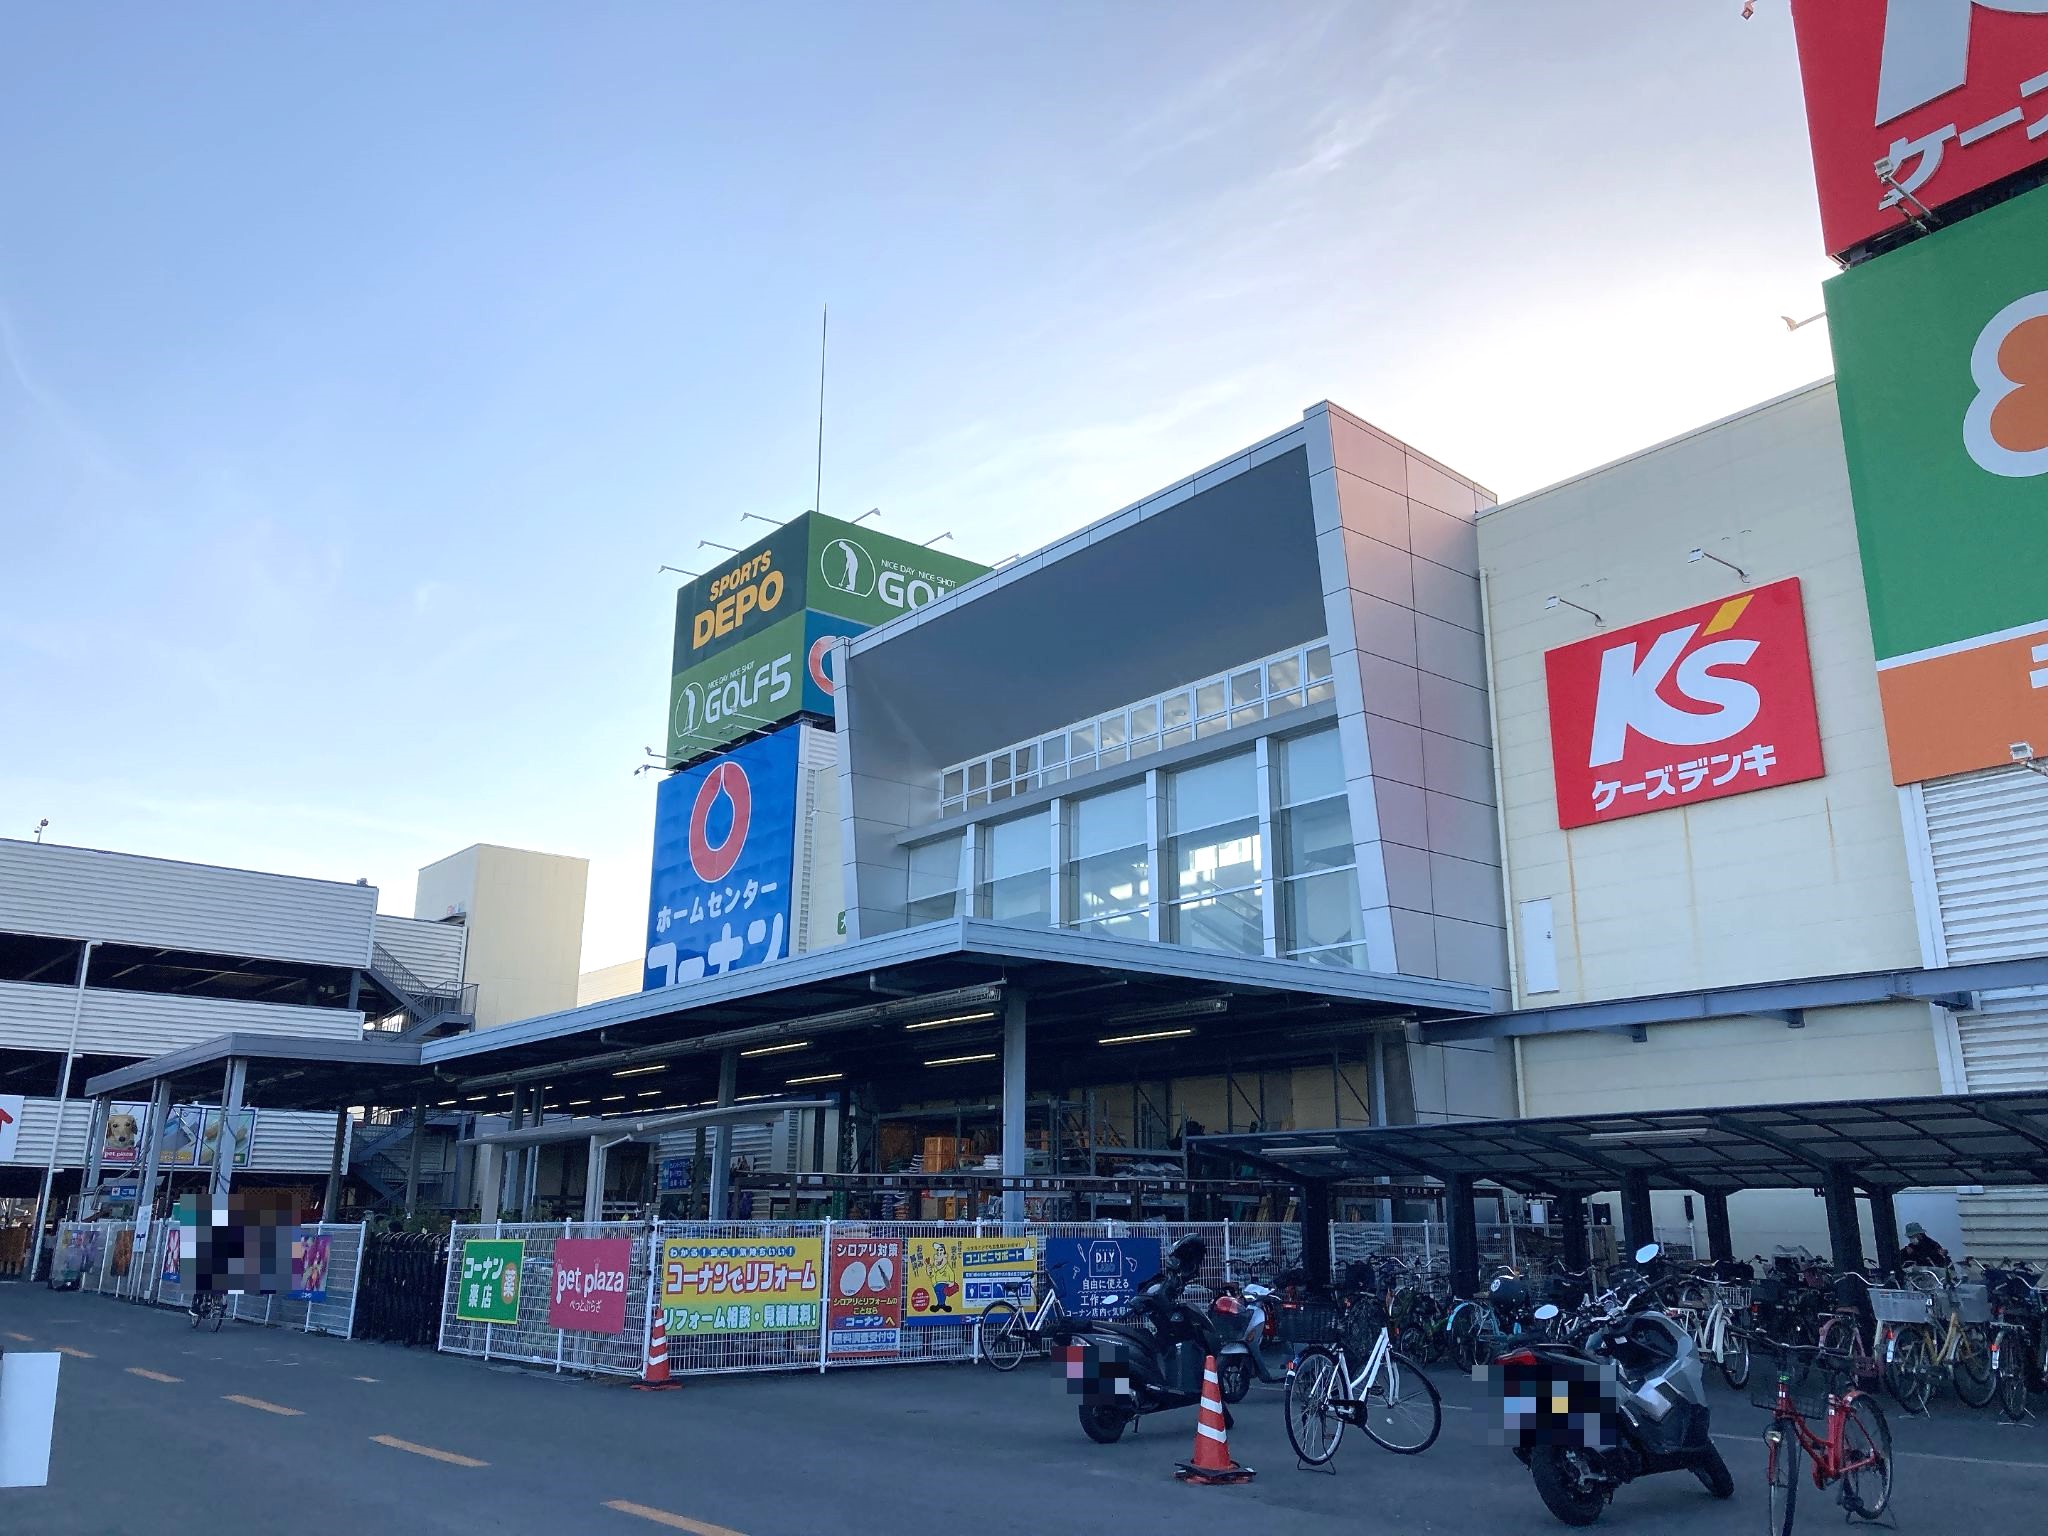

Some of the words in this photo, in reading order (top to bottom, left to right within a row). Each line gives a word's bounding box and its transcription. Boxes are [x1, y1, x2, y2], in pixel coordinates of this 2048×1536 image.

[709, 549, 772, 602] SPORTS
[881, 559, 899, 571] NICE
[900, 564, 916, 576] DAY
[918, 570, 935, 582] NICE
[936, 576, 957, 588] SHOT
[692, 570, 784, 650] DEPO
[705, 653, 792, 724] GOLF5
[707, 679, 719, 690] NICE
[719, 674, 729, 685] DAY
[729, 668, 741, 679] NICE
[741, 660, 755, 674] SHOT
[1591, 743, 1777, 812] ケーズデンキ
[656, 879, 778, 933] ホームセンター
[836, 1243, 899, 1257] シロアリ対策
[965, 1250, 1023, 1264] コンビニサポート
[463, 1256, 504, 1281] コーナン
[556, 1263, 582, 1305] pet
[584, 1263, 625, 1299] plaza
[666, 1261, 817, 1294] コーナンでリフォーム
[1082, 1278, 1130, 1290] 自由に使える
[468, 1283, 493, 1309] 薬店
